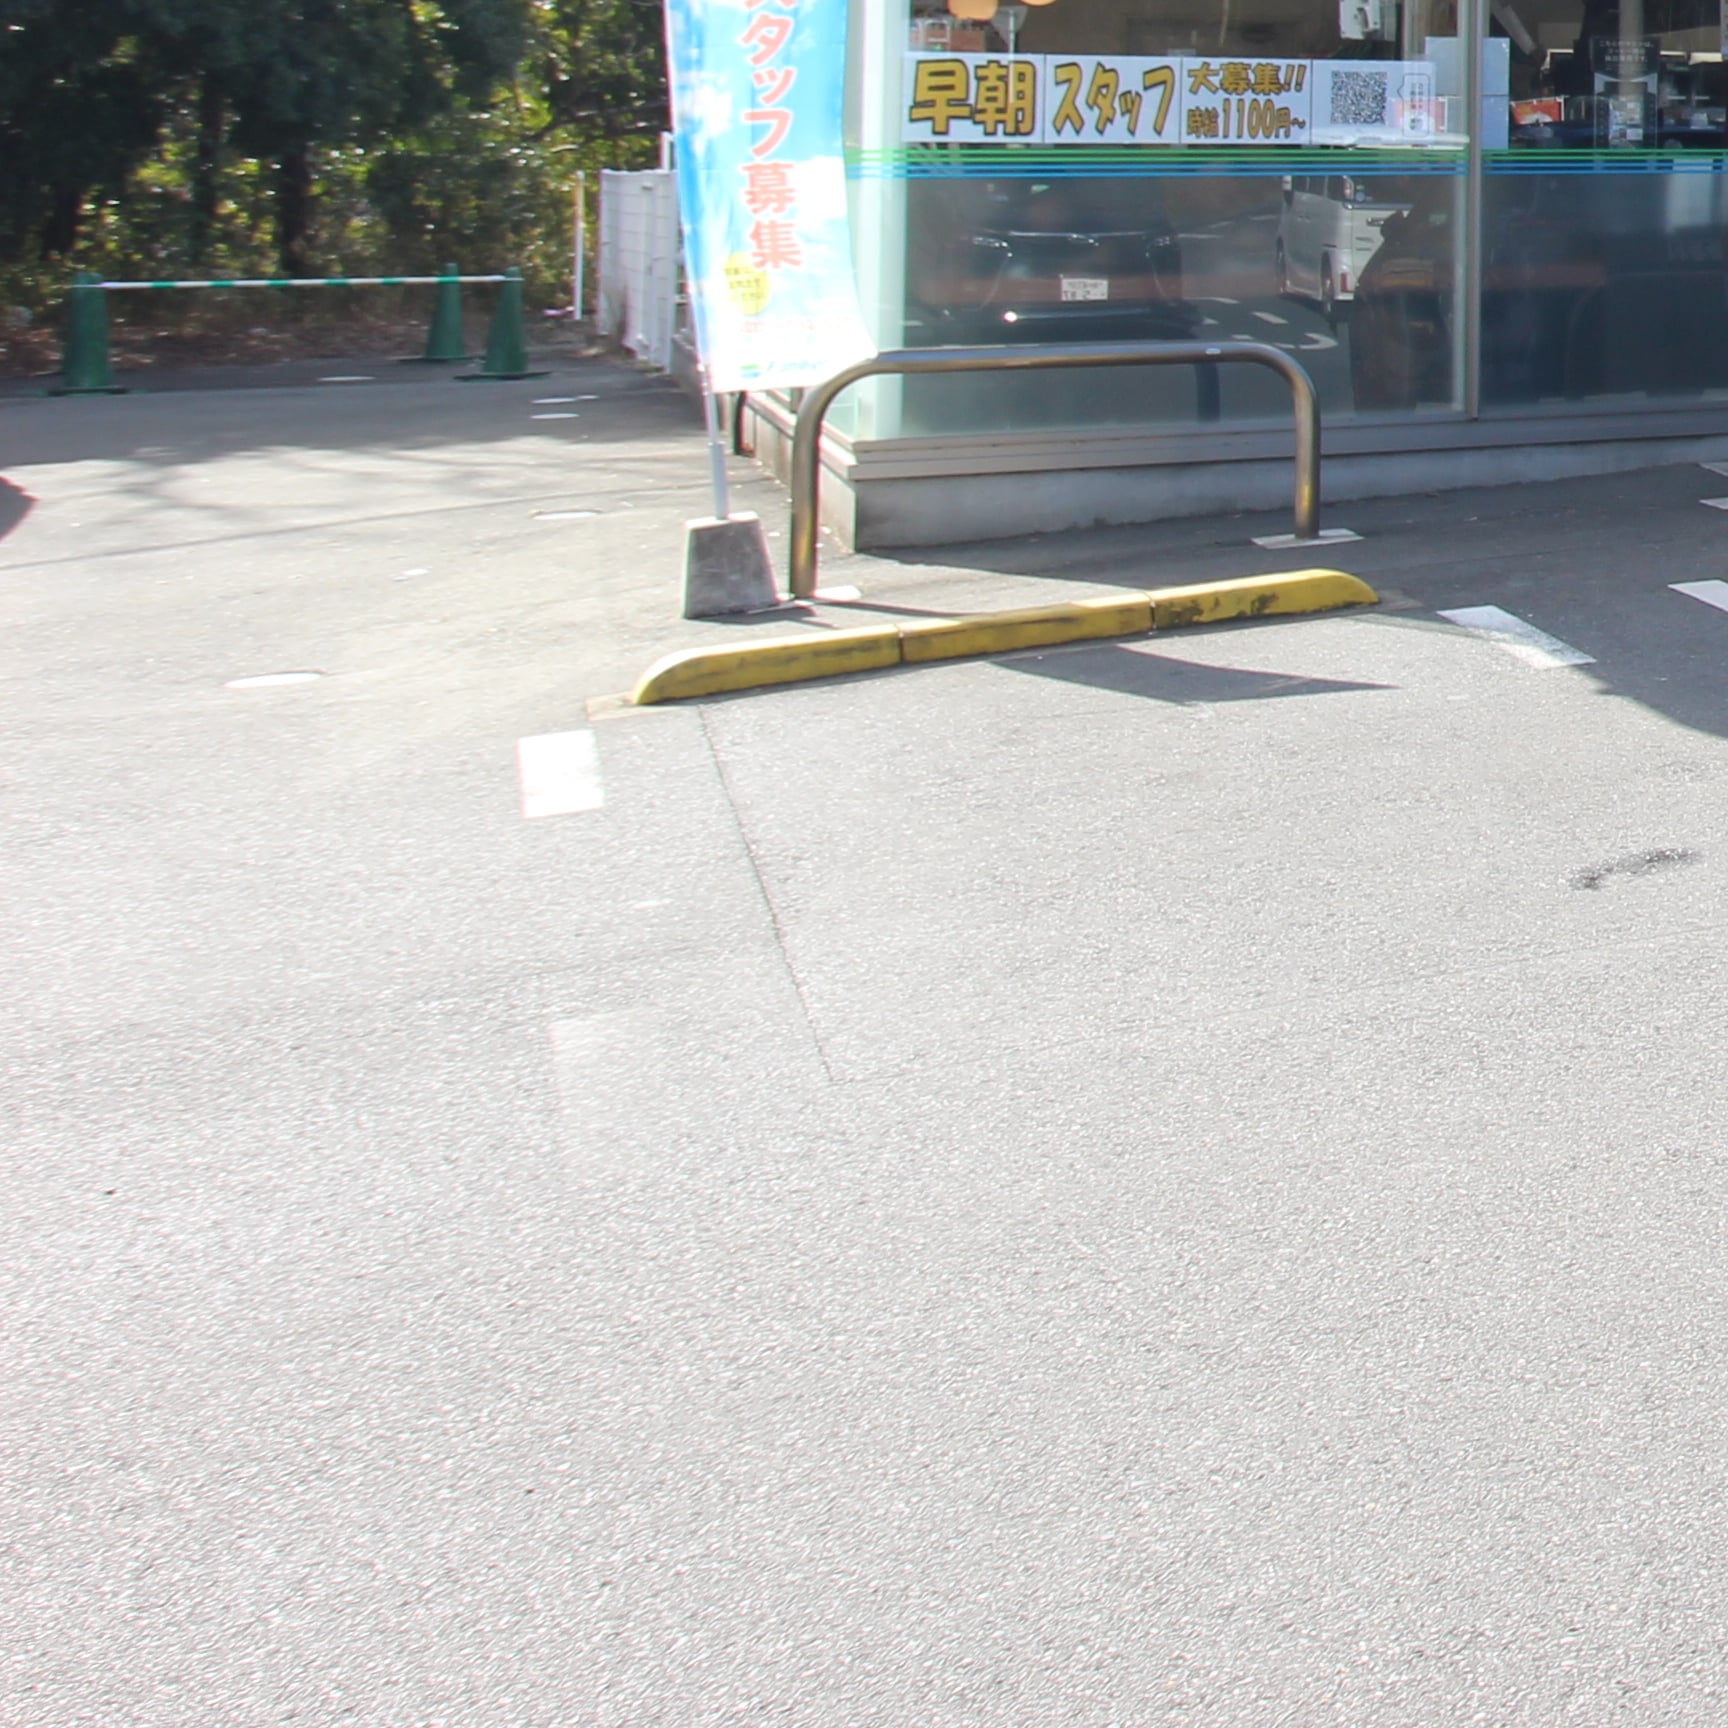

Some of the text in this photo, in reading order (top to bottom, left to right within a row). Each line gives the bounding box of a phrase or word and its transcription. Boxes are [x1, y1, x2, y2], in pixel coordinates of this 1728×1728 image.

[909, 59, 1175, 136] 早朝 スタッフ
